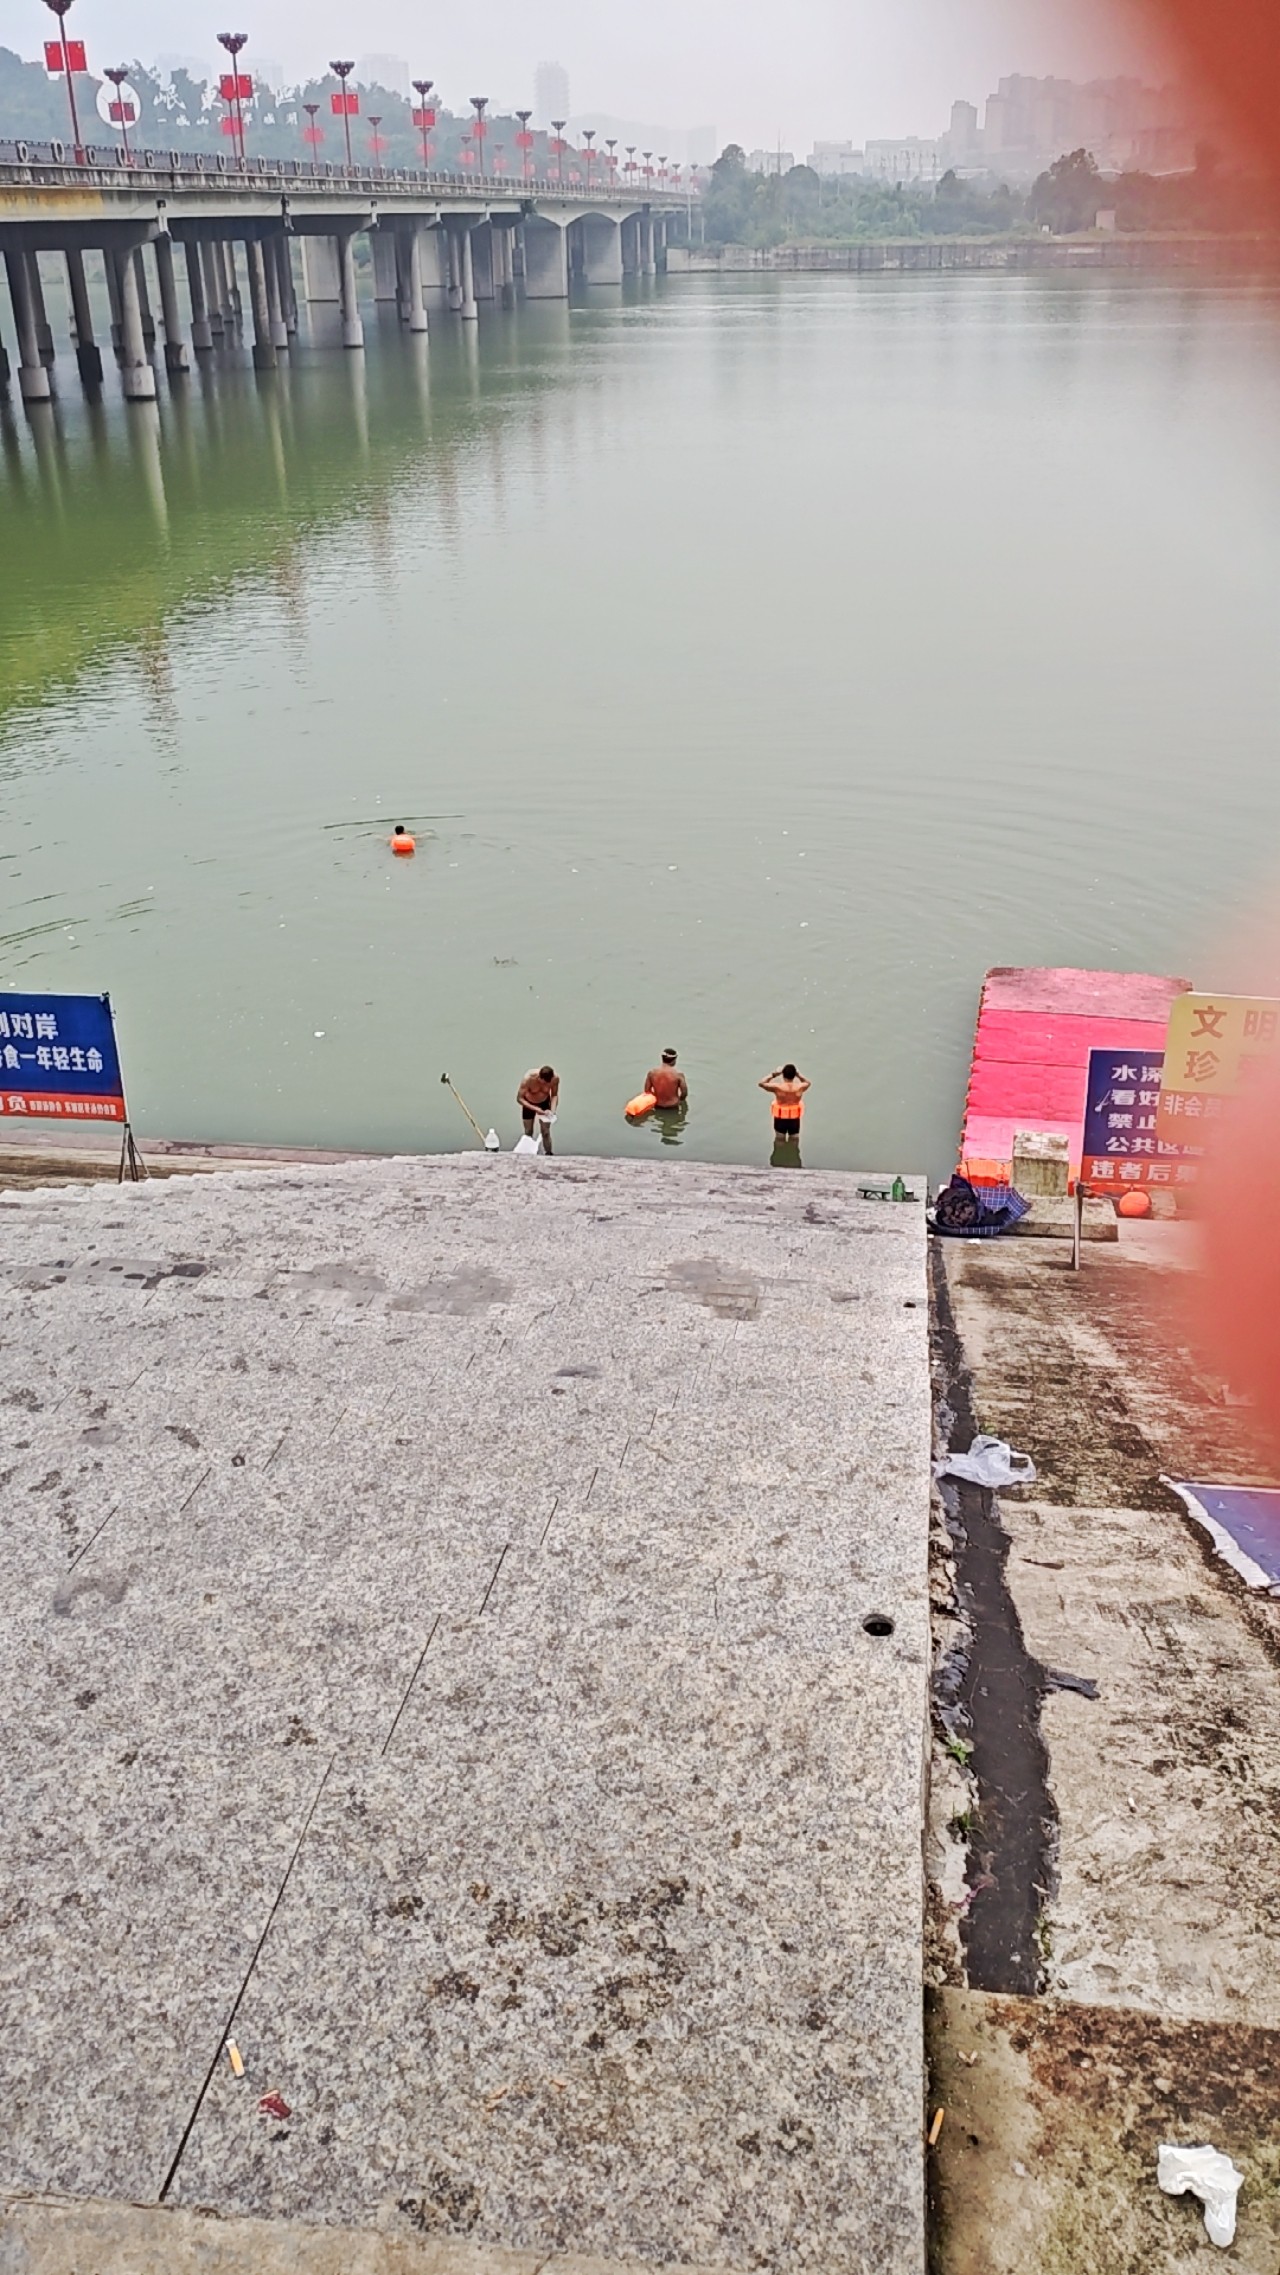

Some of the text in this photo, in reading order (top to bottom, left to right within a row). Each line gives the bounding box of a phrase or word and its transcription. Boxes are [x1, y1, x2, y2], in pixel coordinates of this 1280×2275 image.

[0, 1044, 103, 1073] 食一年轻生命
[1111, 1064, 1162, 1083] 水深
[1107, 1113, 1157, 1130] 禁止
